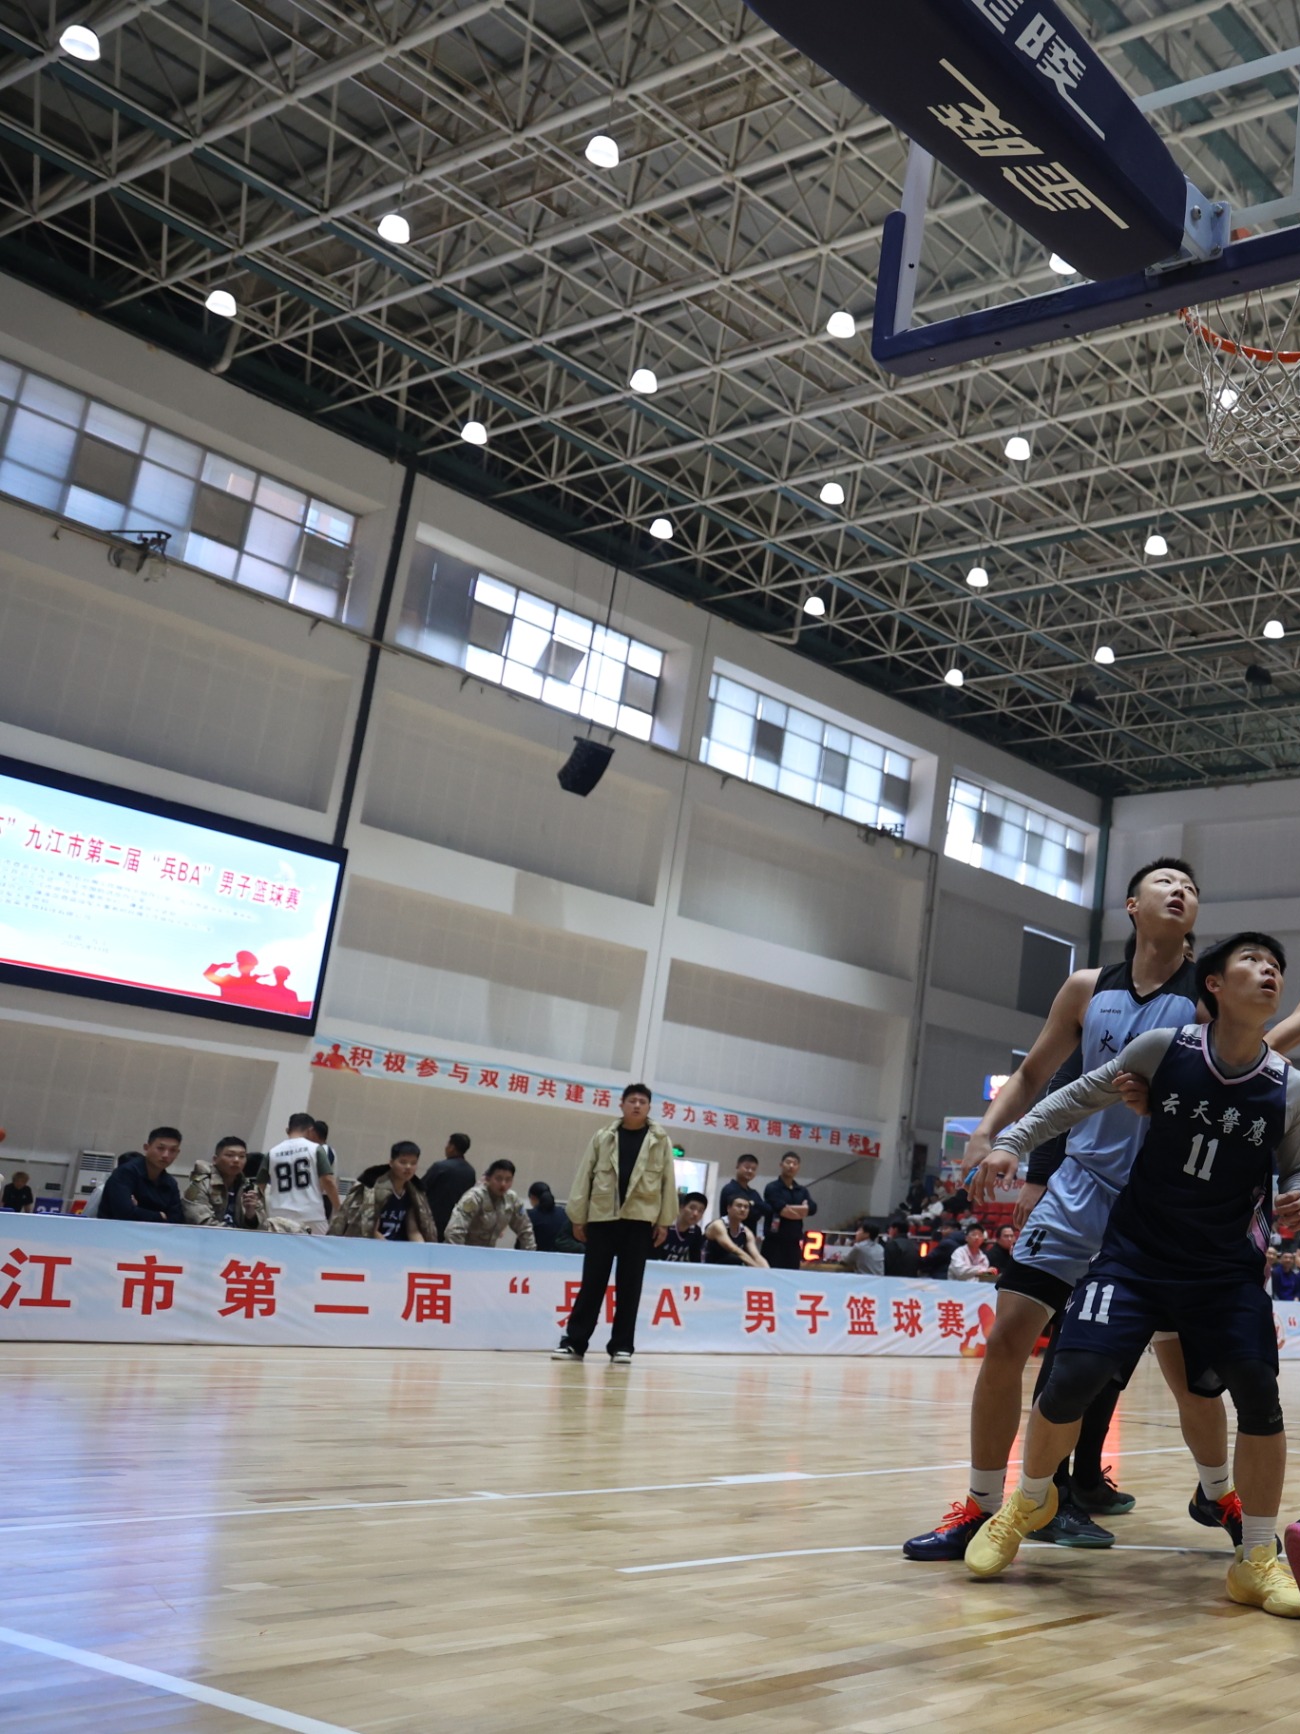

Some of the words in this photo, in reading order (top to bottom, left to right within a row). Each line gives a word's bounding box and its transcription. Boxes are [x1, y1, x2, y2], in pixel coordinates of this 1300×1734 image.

[927, 58, 1129, 230] 金陵
[0, 816, 302, 911] ”九江市第二届“兵BA”男子篮球赛
[348, 1045, 625, 1108] 积极参与双拥共建活
[662, 1101, 863, 1147] 努力实现双拥奋斗目标
[1162, 1092, 1267, 1146] 云天警鹰
[274, 1157, 310, 1192] 86
[1183, 1133, 1219, 1181] 11
[1025, 1229, 1047, 1256] 4
[1078, 1281, 1114, 1324] 11
